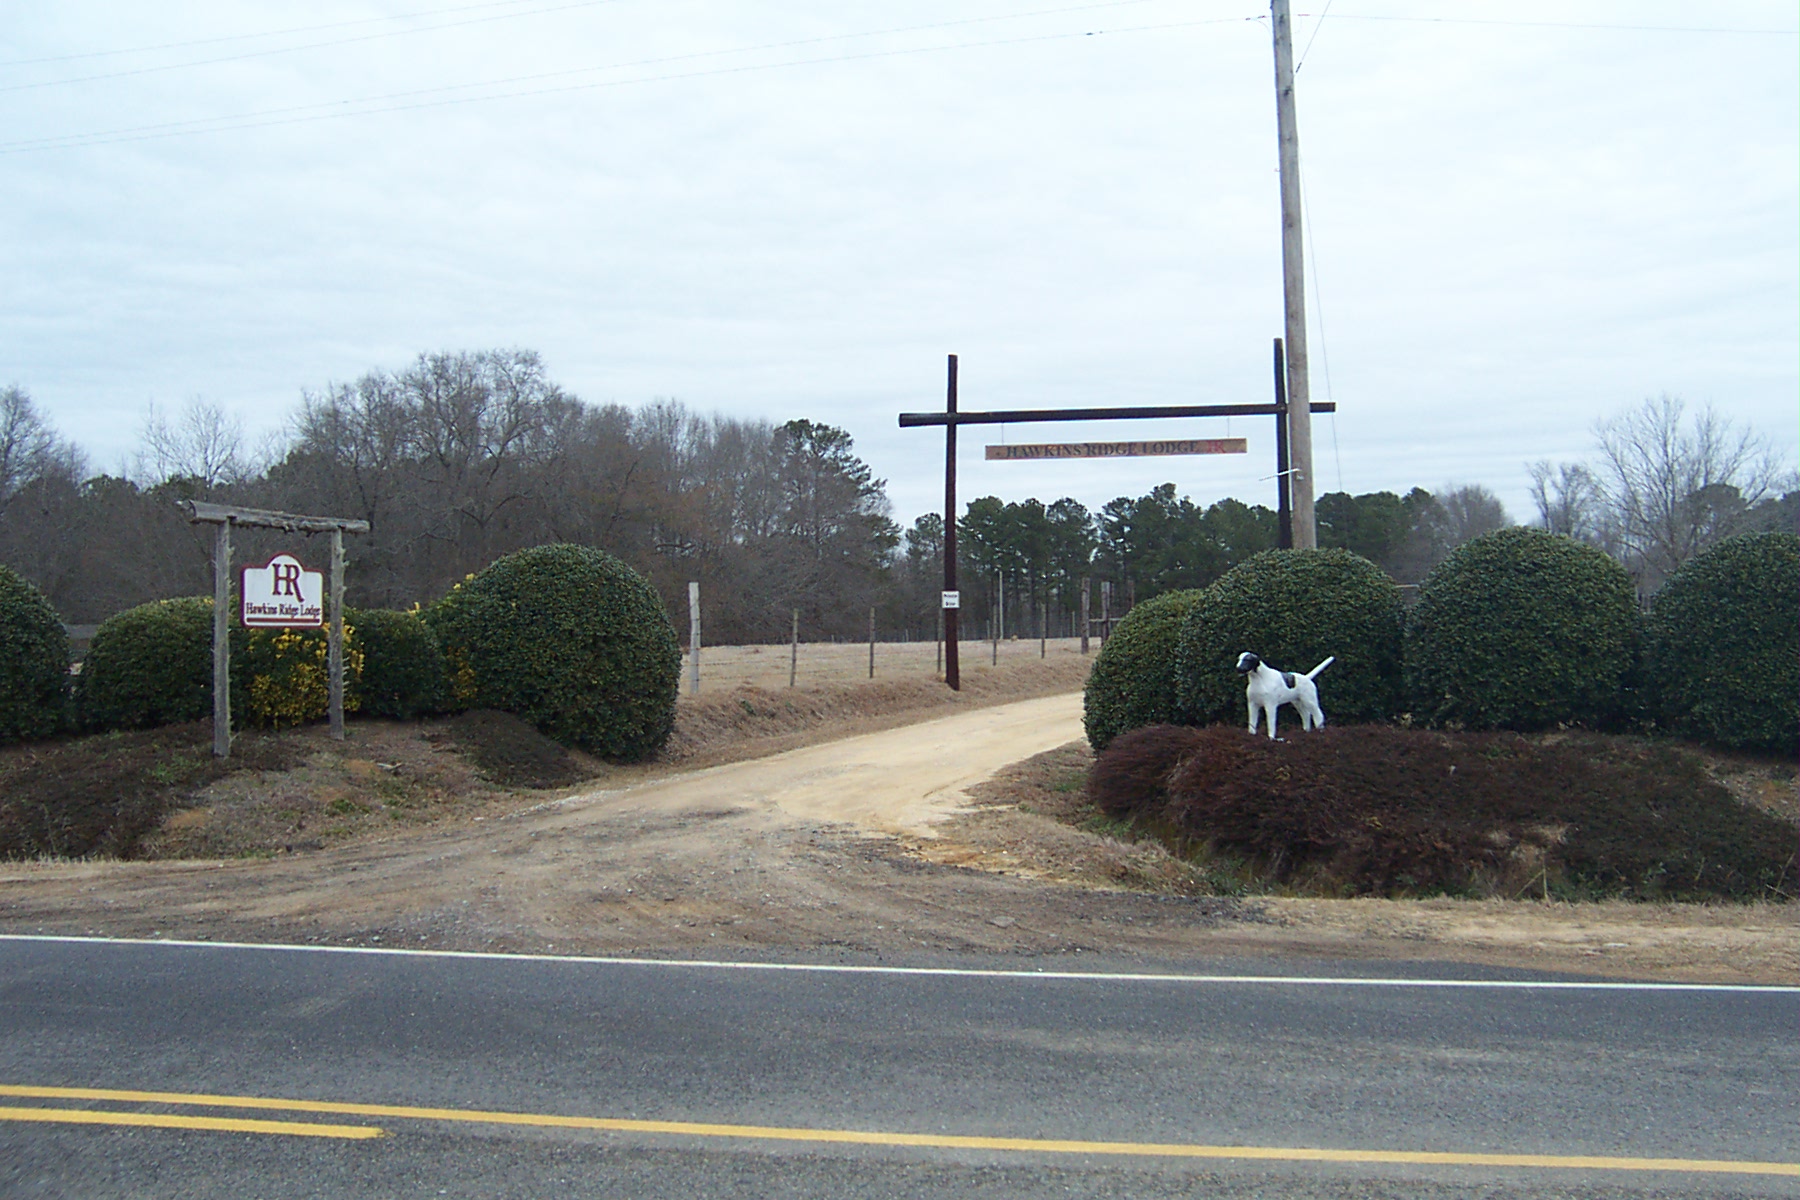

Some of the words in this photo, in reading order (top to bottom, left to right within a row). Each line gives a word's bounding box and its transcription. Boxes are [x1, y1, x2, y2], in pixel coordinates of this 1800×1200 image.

[1006, 445, 1081, 457] HAWKINS
[1083, 443, 1135, 456] RIDGE
[1142, 441, 1198, 454] LODGE
[272, 563, 304, 602] HR
[246, 602, 277, 615] Hawkins
[279, 604, 299, 619] Ridge
[300, 604, 321, 619] Lodge
